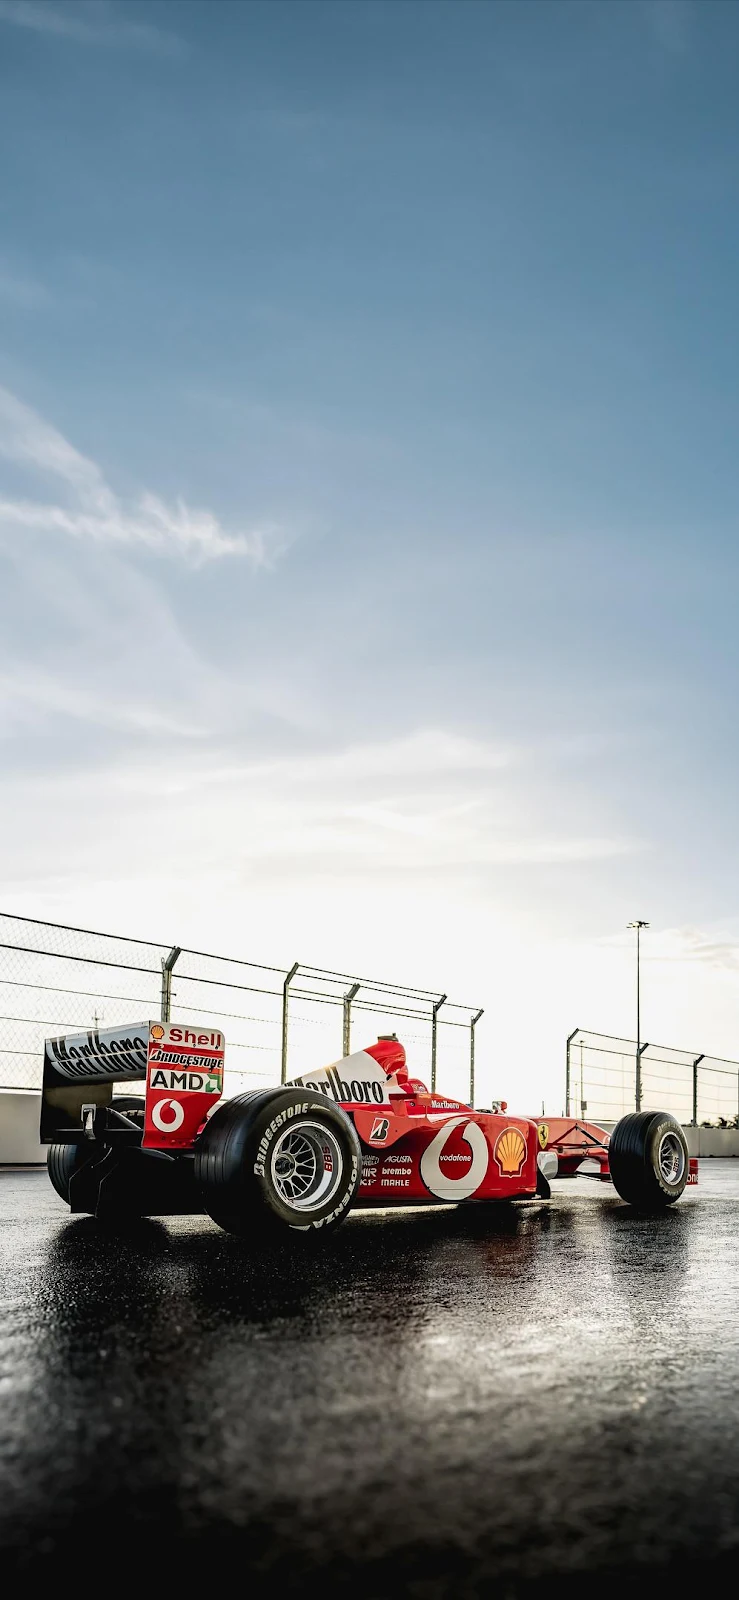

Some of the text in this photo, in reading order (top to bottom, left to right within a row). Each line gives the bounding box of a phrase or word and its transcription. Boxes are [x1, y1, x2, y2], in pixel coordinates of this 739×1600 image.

[169, 1028, 222, 1046] Shell
[51, 1031, 149, 1077] Marlboro
[149, 1049, 223, 1069] BRIDGESTONE
[151, 1071, 204, 1091] AMD
[431, 1100, 460, 1109] Marlboro
[253, 1102, 309, 1177] BRIDGESTONE
[384, 1155, 413, 1163] AGUSTA
[439, 1154, 472, 1162] vodafone
[381, 1167, 412, 1175] brembo
[312, 1155, 358, 1229] POTENZA
[380, 1179, 411, 1187] MAHLE
